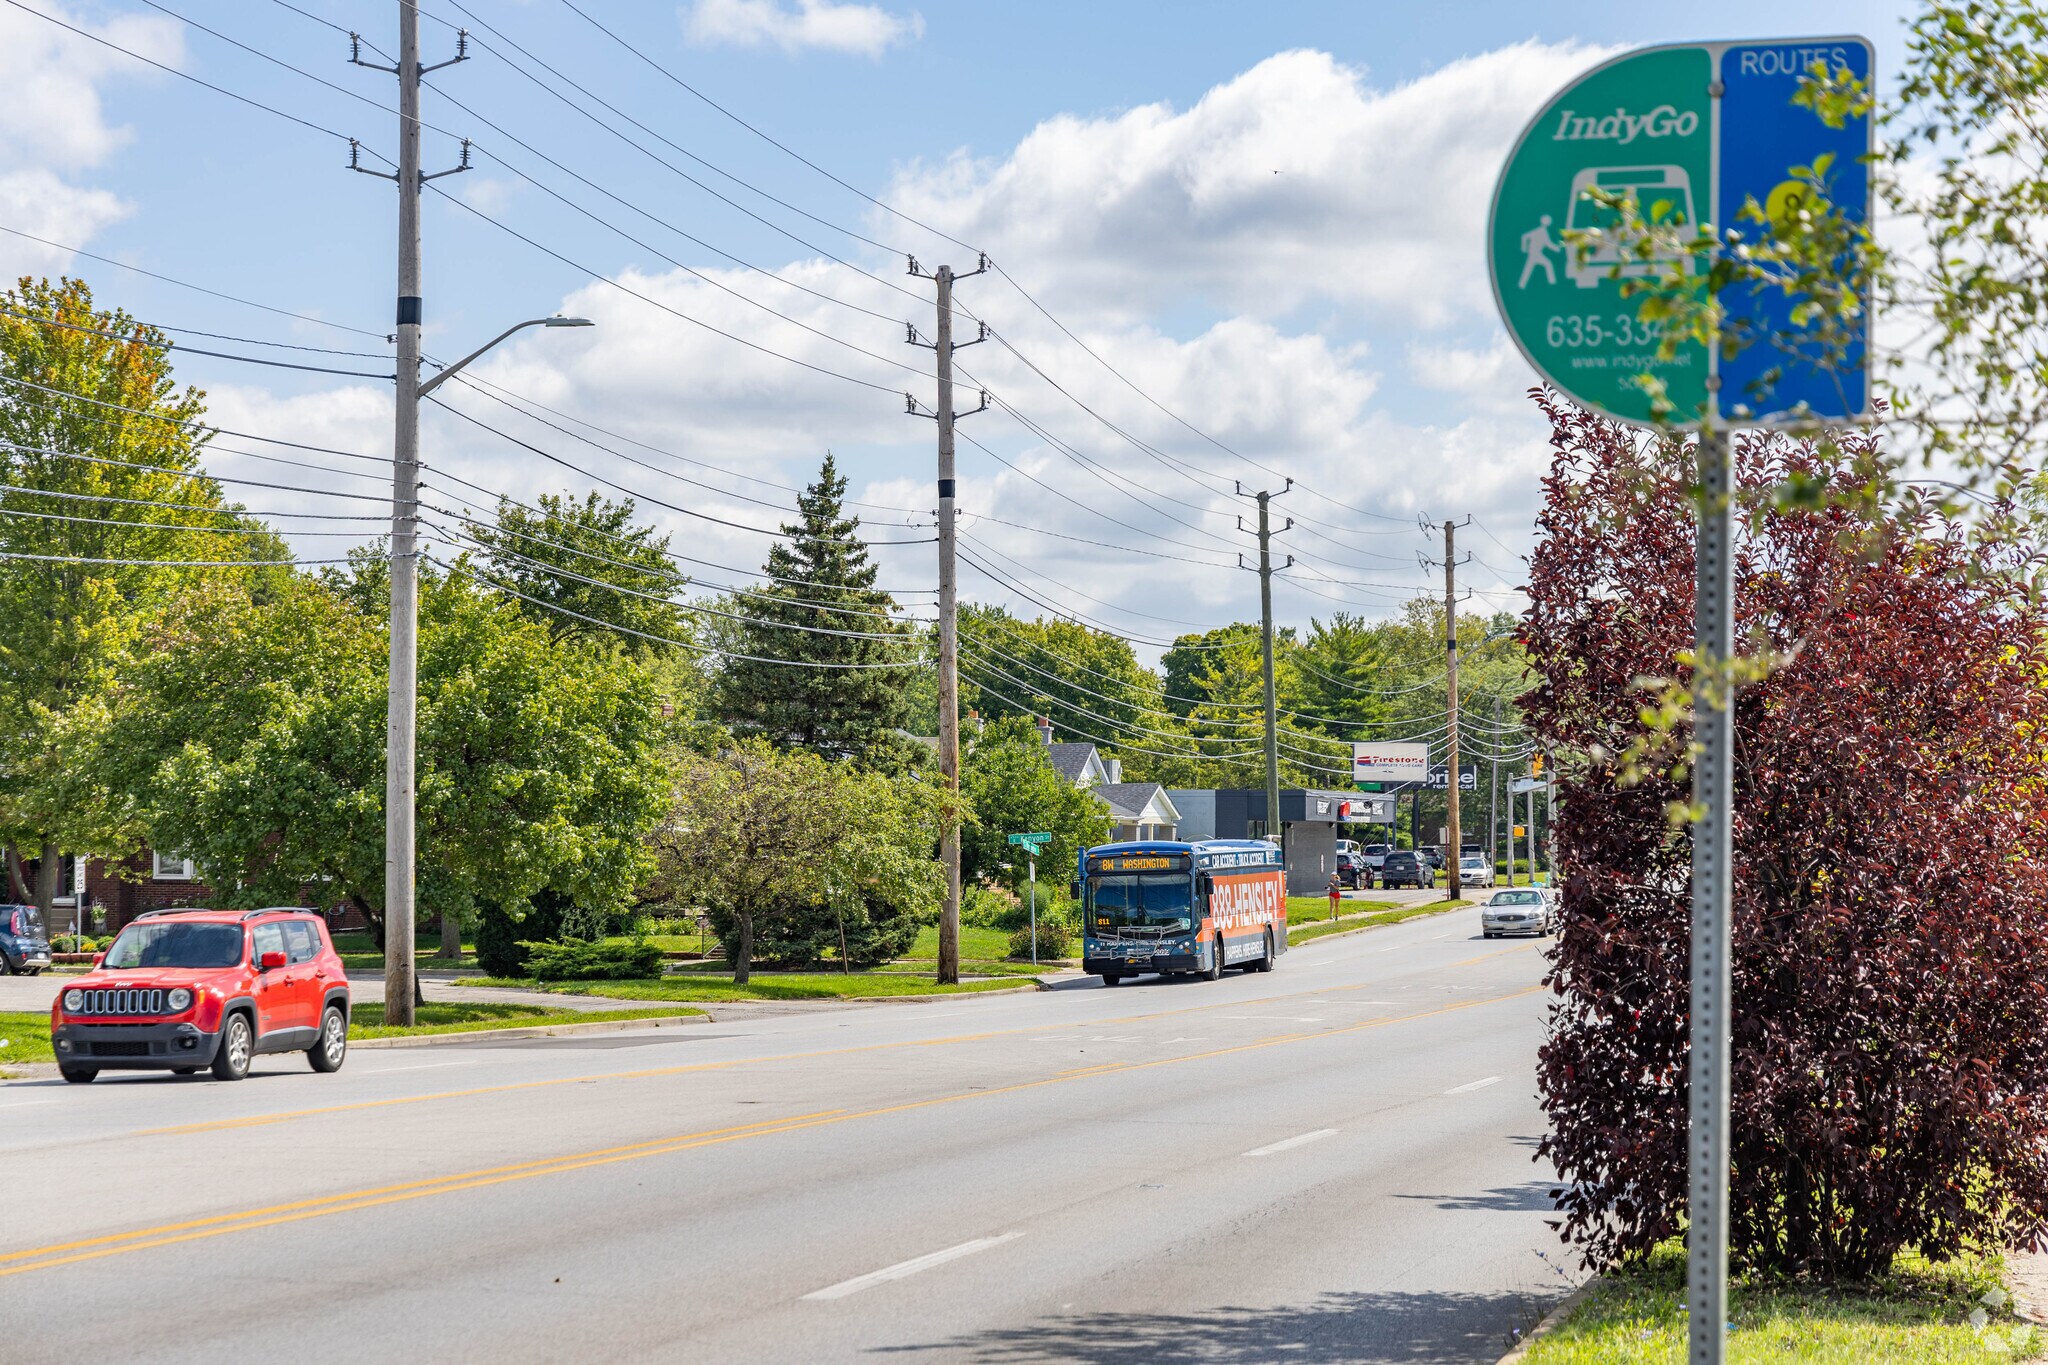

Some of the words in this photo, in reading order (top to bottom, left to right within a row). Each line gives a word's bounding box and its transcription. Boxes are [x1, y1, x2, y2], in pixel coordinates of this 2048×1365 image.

[1741, 47, 1848, 75] ROUTES
[1552, 104, 1699, 145] IndyGo
[1102, 859, 1114, 871] 8W
[1122, 857, 1170, 869] WASHINGTON
[1212, 881, 1278, 930] 888-HENSLEY
